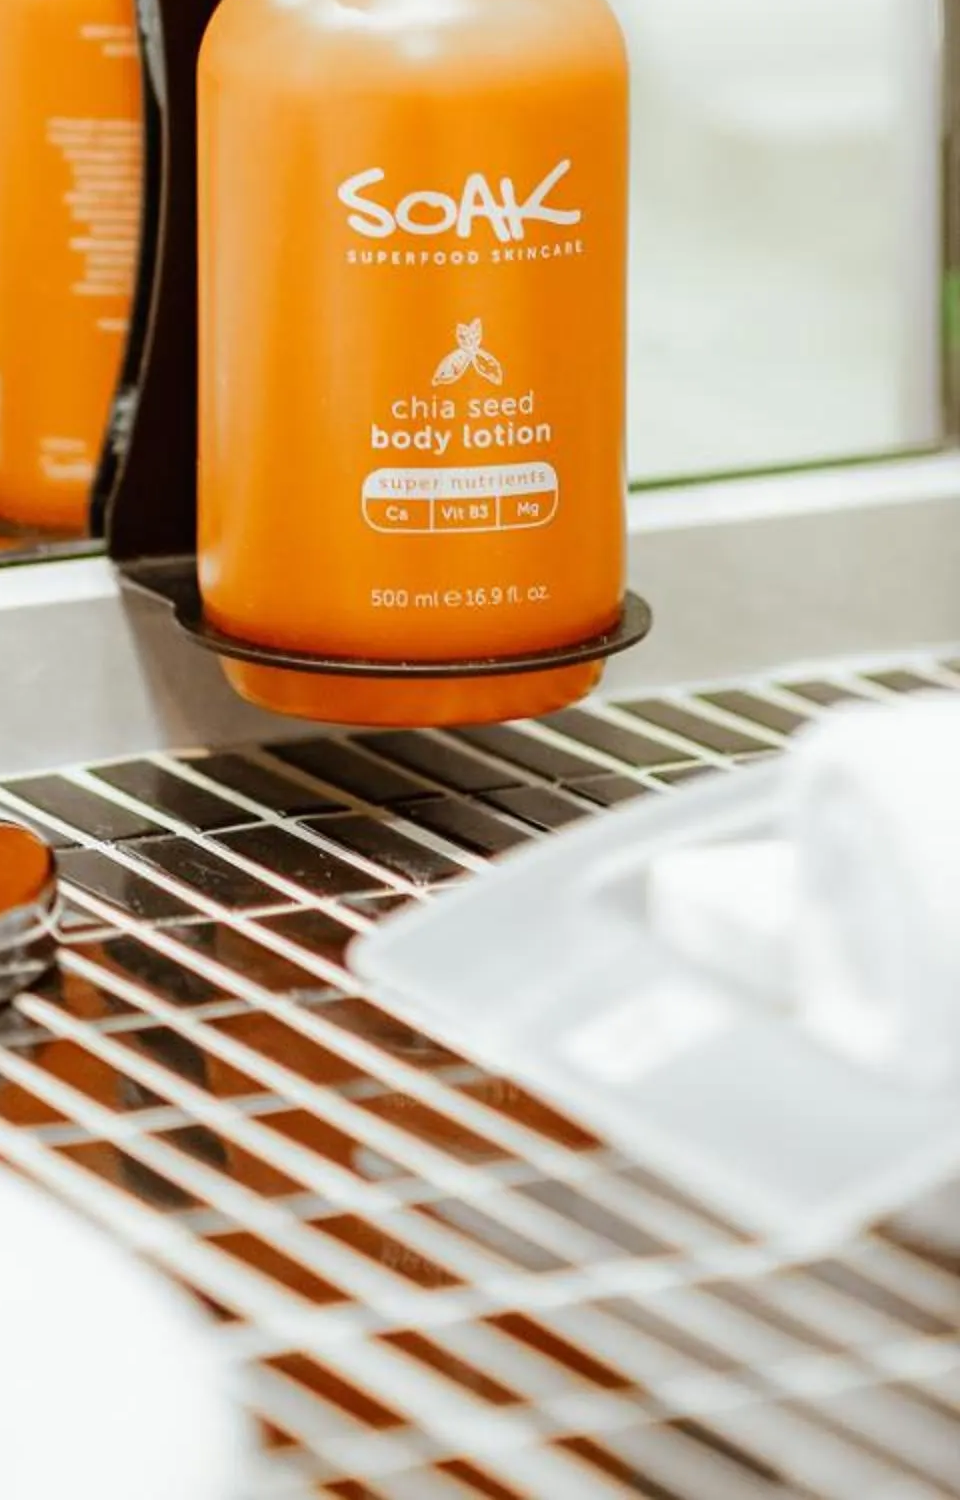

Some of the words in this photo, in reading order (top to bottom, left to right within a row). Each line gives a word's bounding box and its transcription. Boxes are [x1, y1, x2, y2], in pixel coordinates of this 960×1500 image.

[346, 250, 479, 265] SUPERFOOD
[491, 240, 583, 263] SKINCARE
[391, 395, 455, 419] chia
[468, 390, 534, 418] seed
[371, 424, 451, 455] body
[463, 422, 551, 449] lotion
[378, 475, 439, 493] super
[451, 469, 546, 490] nutrients
[385, 505, 409, 521] Ca
[441, 505, 464, 520] Vit
[517, 500, 539, 517] Mg
[371, 588, 409, 608] 500
[415, 592, 439, 608] ml
[465, 586, 503, 606] 16.9
